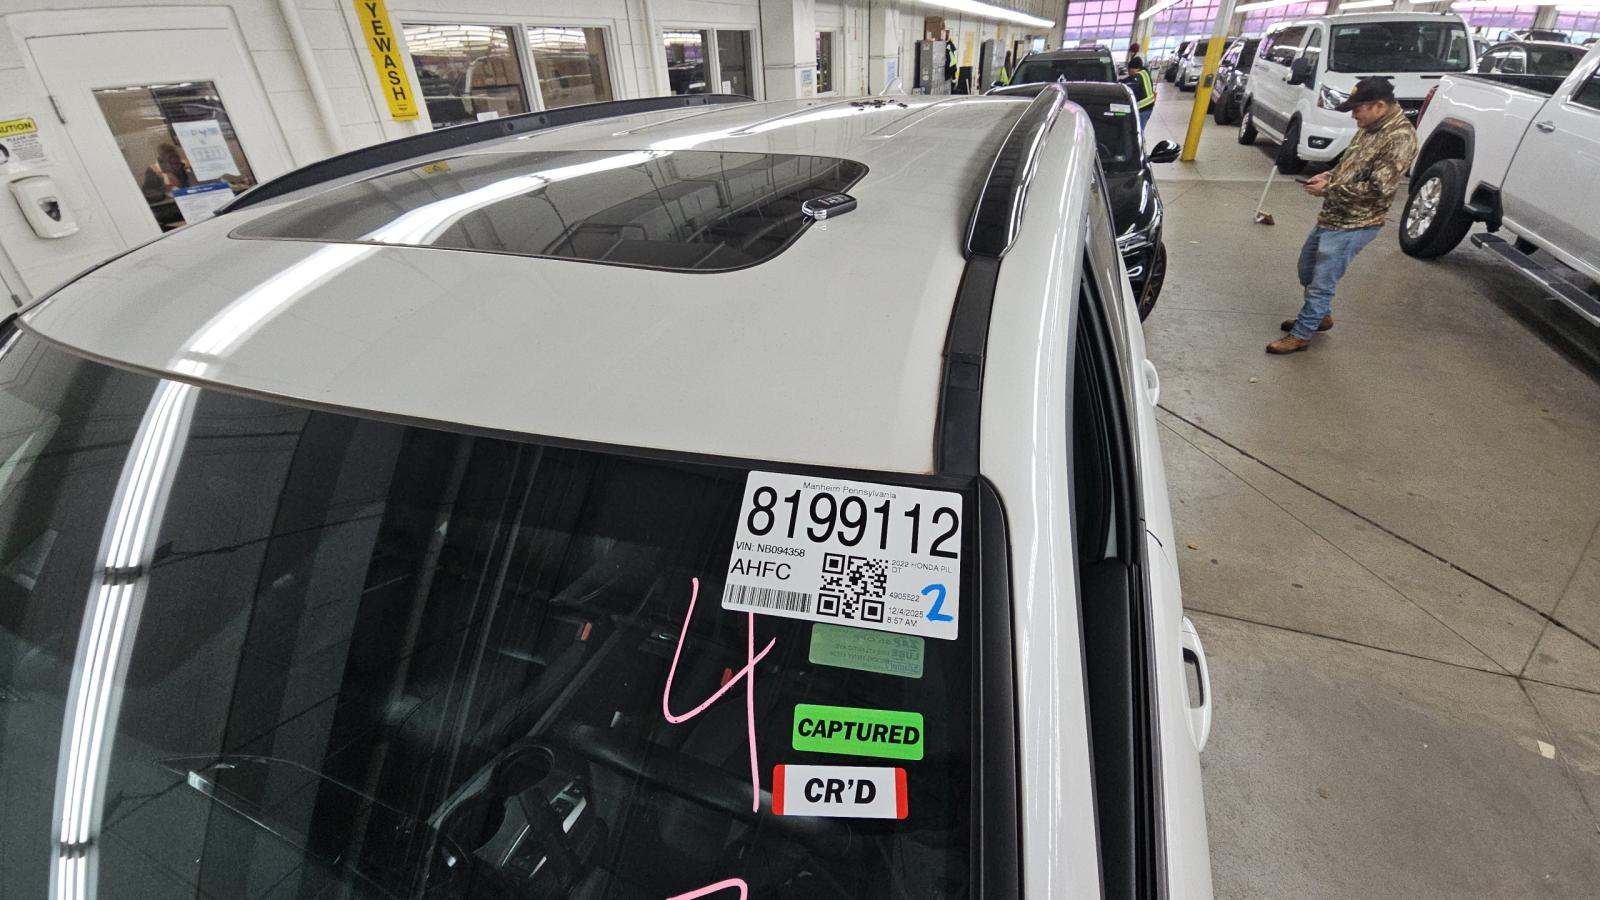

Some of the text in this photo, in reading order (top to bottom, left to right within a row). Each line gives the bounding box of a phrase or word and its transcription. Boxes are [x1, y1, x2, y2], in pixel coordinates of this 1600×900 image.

[364, 0, 406, 101] YEWASH
[803, 481, 897, 499] Manheim Pennsylvania
[747, 485, 959, 559] 8199112
[736, 541, 806, 557] VIN: NB094358
[730, 558, 791, 580] AHFC
[891, 559, 952, 573] 2022 HONDA PIL
[889, 592, 920, 602] 4905522
[921, 584, 954, 621] 2
[889, 607, 924, 618] 12/4/2025
[662, 576, 778, 813] 4
[798, 718, 920, 745] CAPTURED
[804, 777, 877, 804] CR'D
